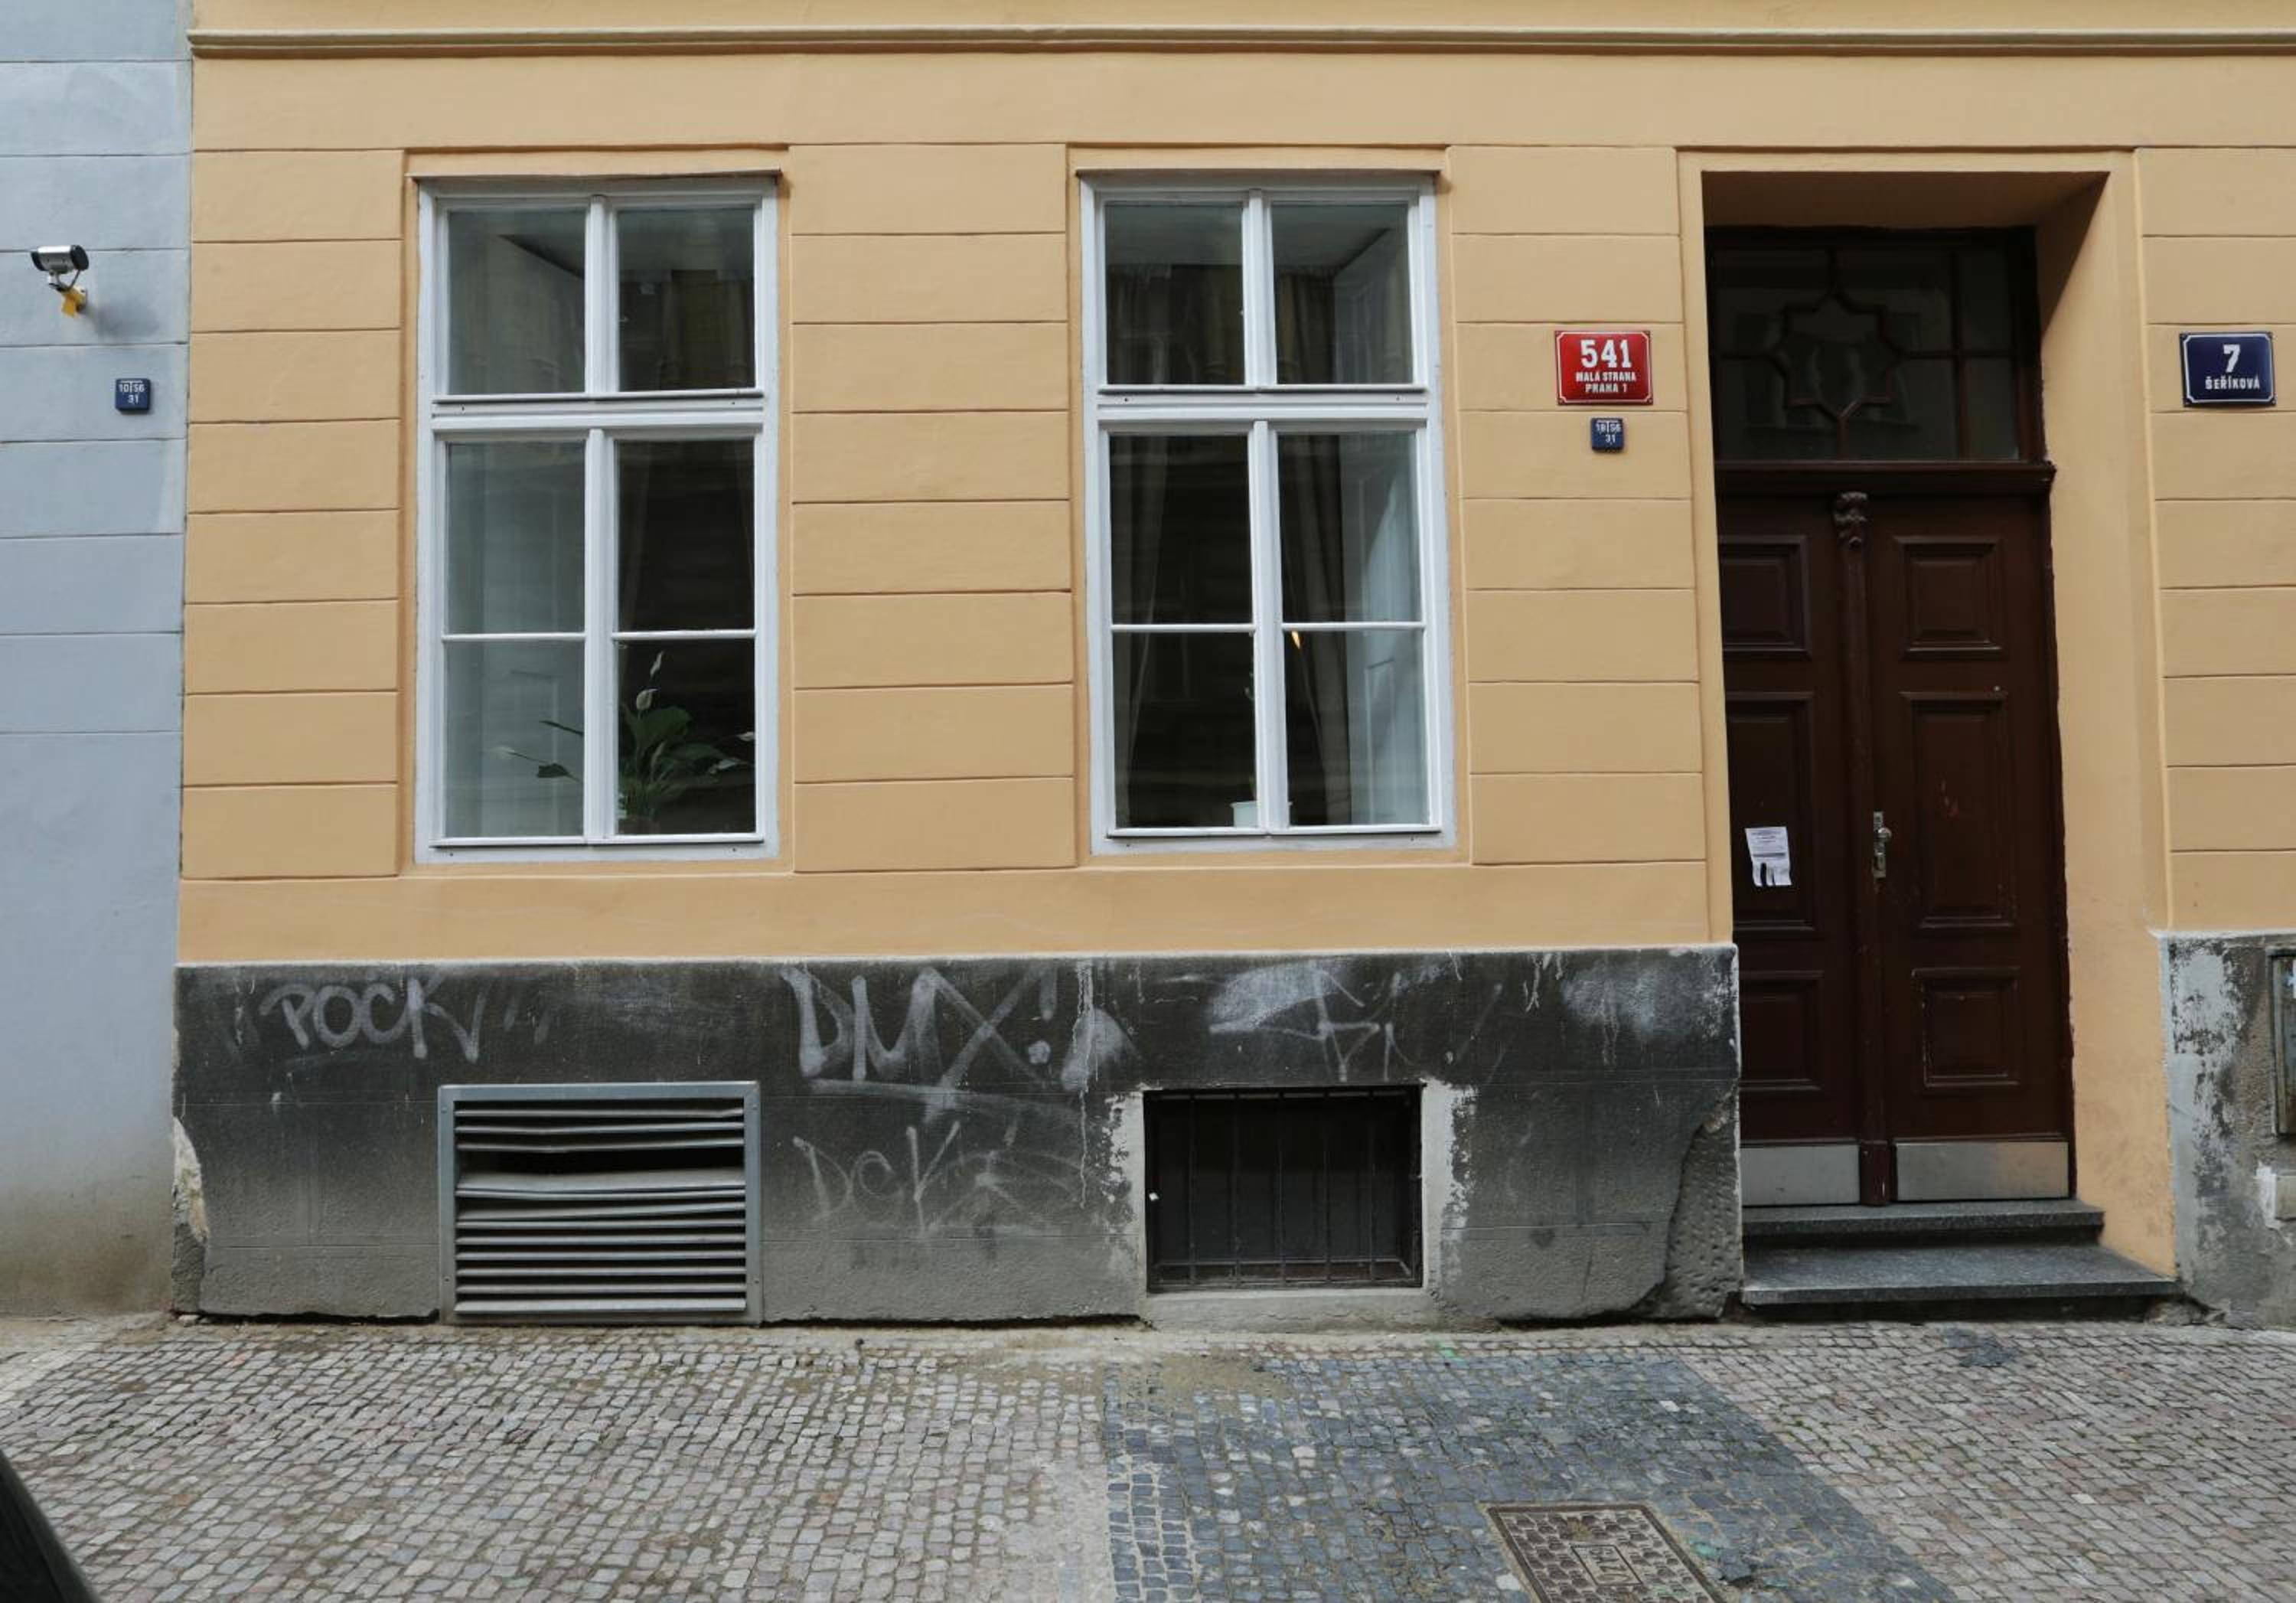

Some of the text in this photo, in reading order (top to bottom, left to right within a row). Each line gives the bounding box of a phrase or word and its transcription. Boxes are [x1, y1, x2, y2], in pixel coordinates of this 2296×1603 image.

[1580, 339, 1632, 368] 541
[2223, 344, 2241, 373] 7
[1602, 371, 1637, 382] STRANA
[1585, 383, 1628, 393] PRAHA 1
